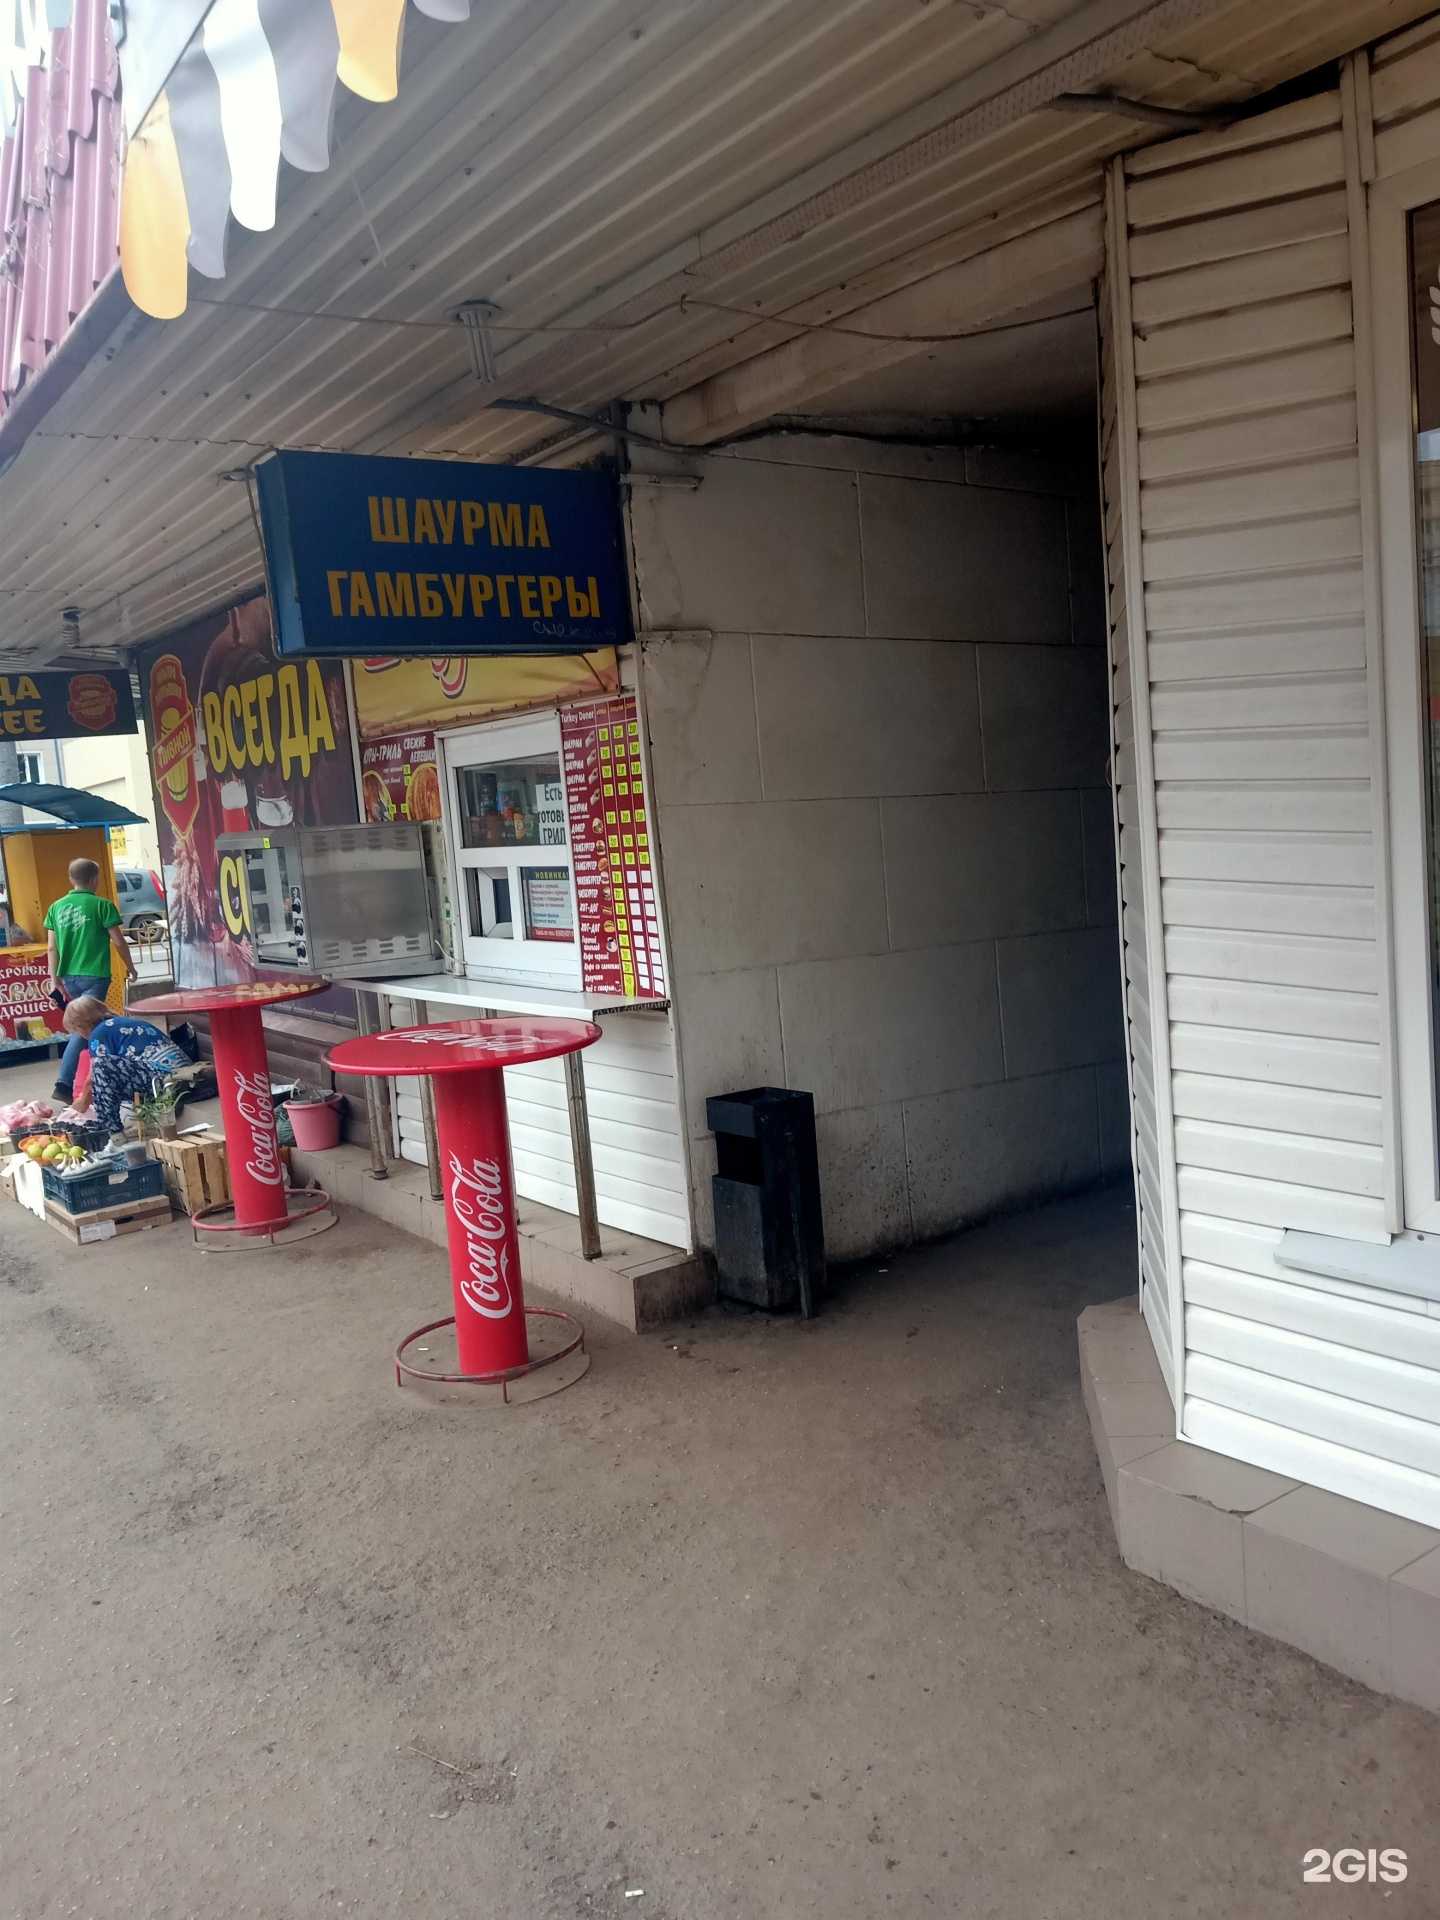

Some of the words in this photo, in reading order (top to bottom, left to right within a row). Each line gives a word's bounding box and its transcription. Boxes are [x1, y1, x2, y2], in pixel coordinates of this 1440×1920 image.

[367, 496, 551, 548] ШАУРМА
[326, 570, 601, 618] ГАМБУРГЕРЫ
[203, 659, 336, 781] ВСЕГДА
[403, 736, 426, 750] СВЕЖИЕ
[234, 1067, 281, 1185] Coca-Cola
[448, 1149, 513, 1319] Coca-Cola
